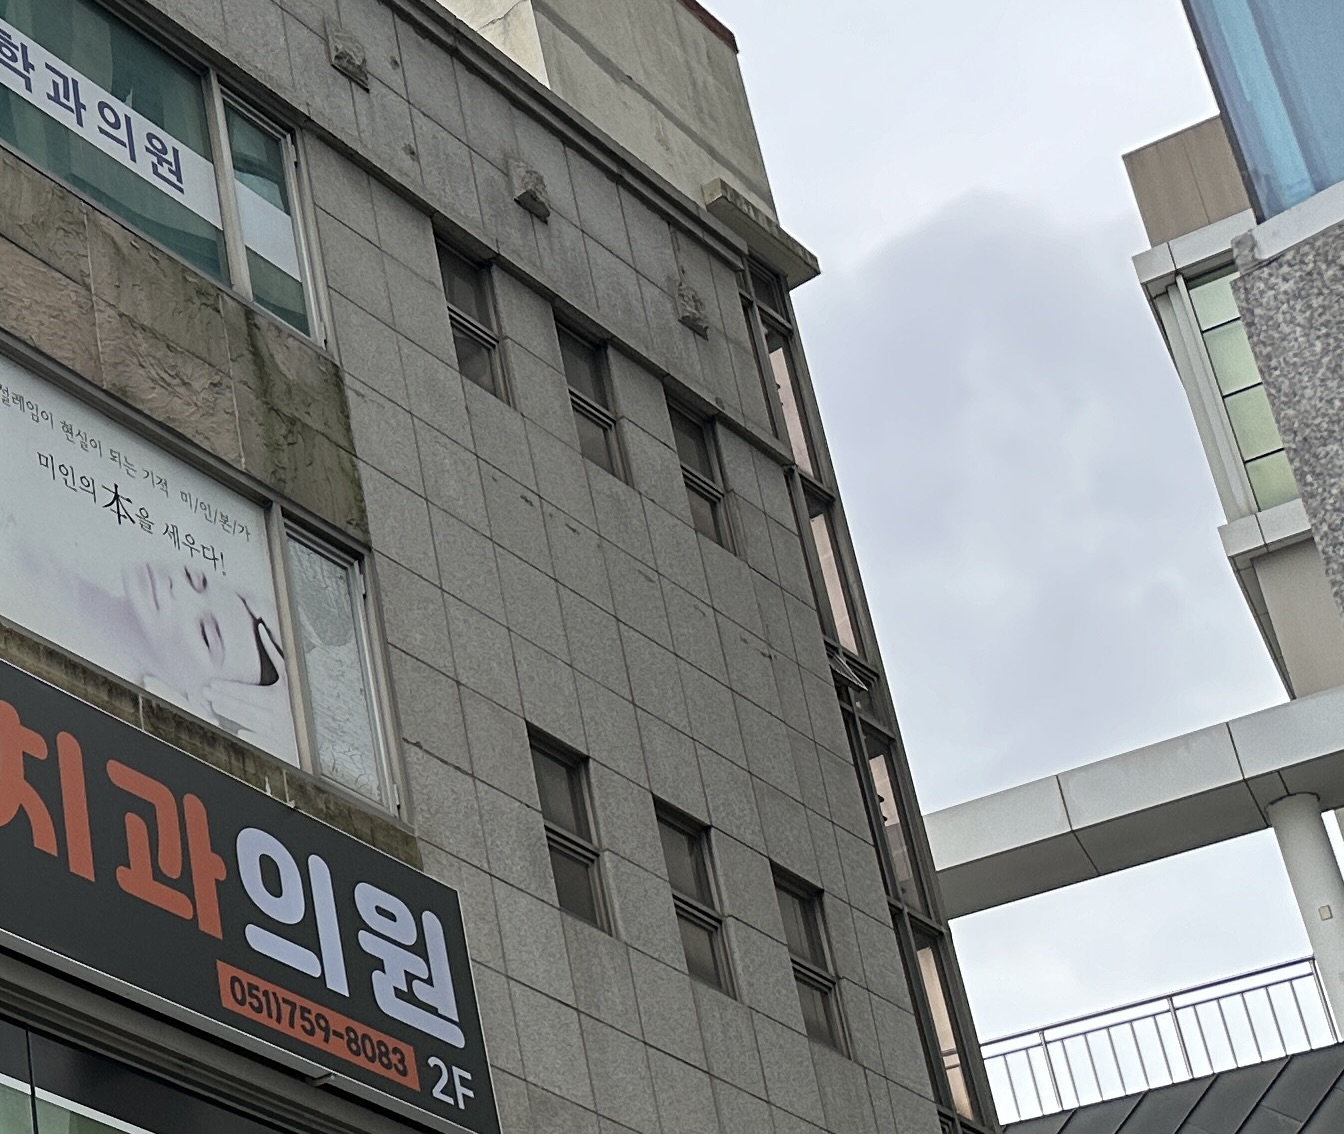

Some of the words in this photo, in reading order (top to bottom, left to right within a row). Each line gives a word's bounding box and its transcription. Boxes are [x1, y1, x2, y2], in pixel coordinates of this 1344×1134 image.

[37, 450, 97, 504] 미인의
[162, 522, 227, 577] 세우다!
[427, 1056, 475, 1110] 2F
